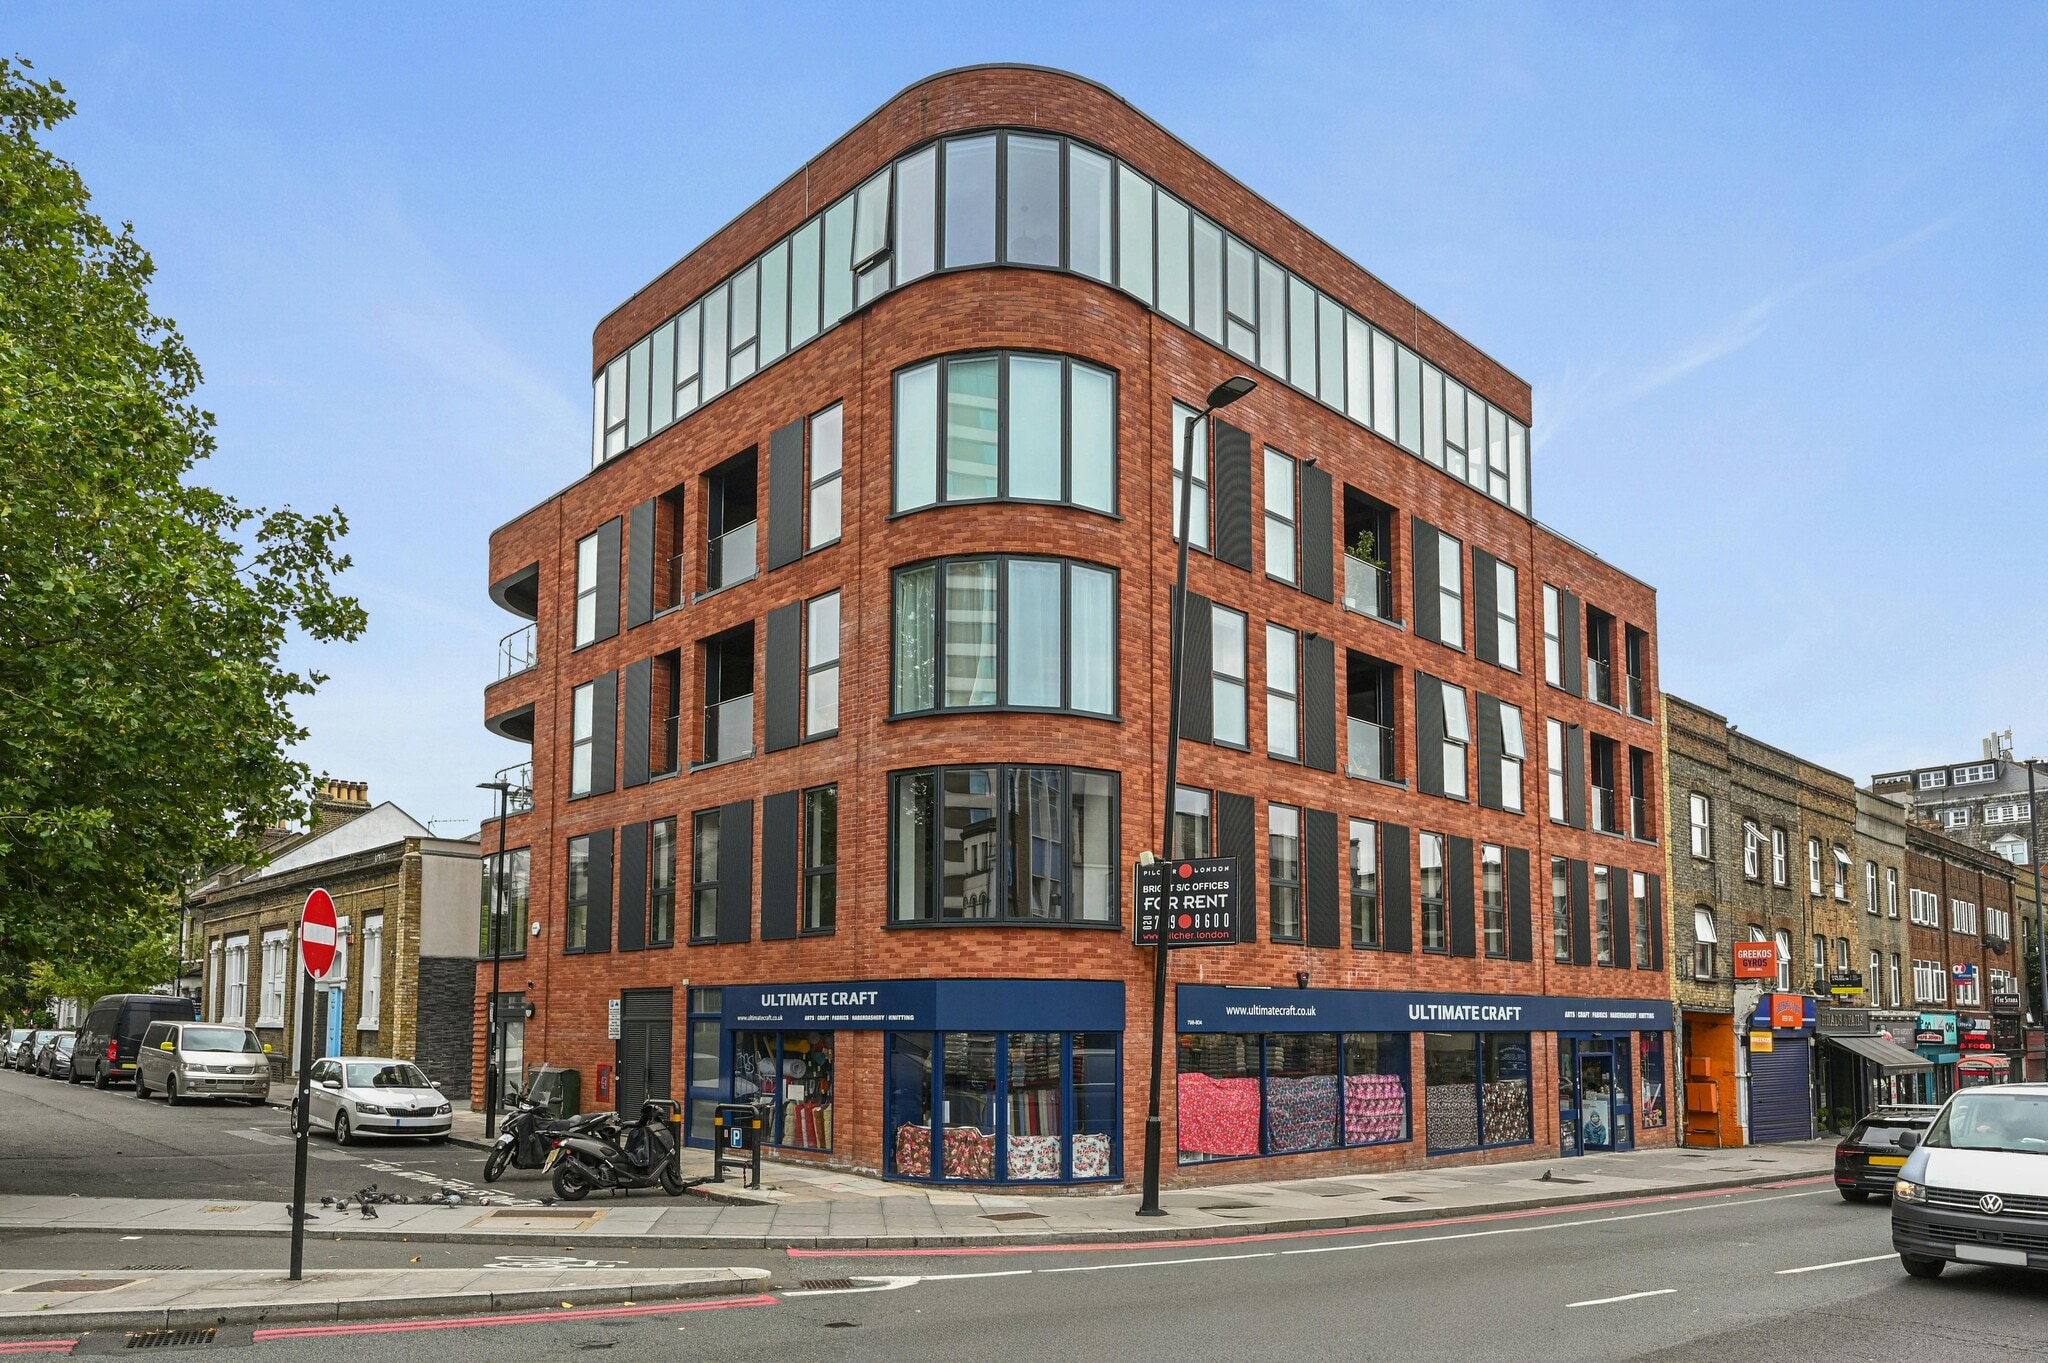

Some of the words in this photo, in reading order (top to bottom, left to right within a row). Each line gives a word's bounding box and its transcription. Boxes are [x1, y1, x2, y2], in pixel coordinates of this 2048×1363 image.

[1194, 865, 1230, 873] LONDON
[1142, 884, 1175, 893] BRIGT
[1176, 883, 1190, 892] S/C
[1192, 881, 1230, 891] OFFICES
[1183, 894, 1229, 909] RENT
[1194, 912, 1229, 929] 8600
[1142, 931, 1229, 940] wwwilcher.london
[1737, 949, 1772, 959] GREEKOS
[1742, 958, 1768, 967] GYROS
[761, 992, 829, 1007] ULTIMATE
[831, 991, 878, 1006] CRAFT
[1225, 1004, 1317, 1016] www.ultimatecraft.co.uk
[1408, 1004, 1480, 1020] ULTIMATE
[1481, 1005, 1522, 1021] CRAFT
[733, 1130, 740, 1146] P
